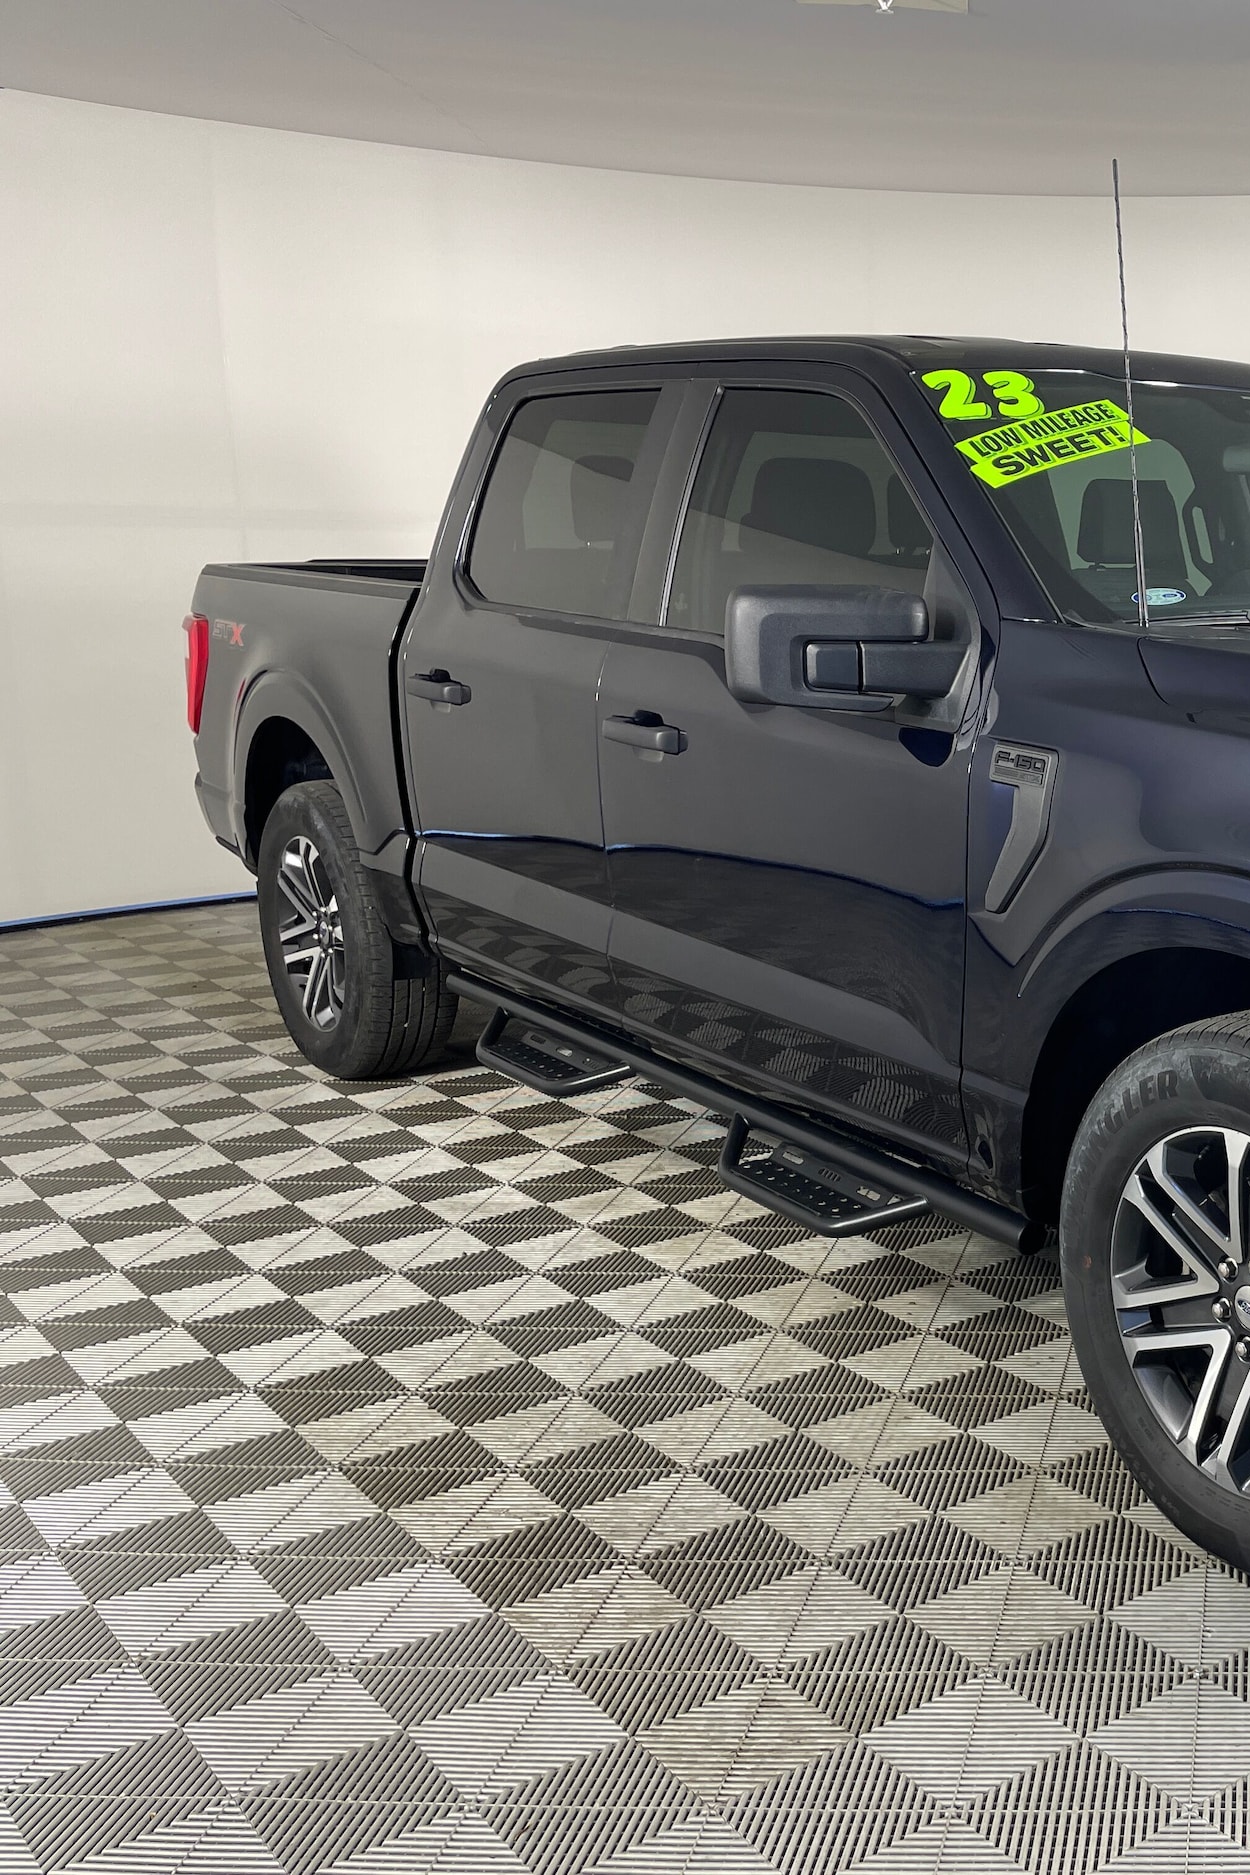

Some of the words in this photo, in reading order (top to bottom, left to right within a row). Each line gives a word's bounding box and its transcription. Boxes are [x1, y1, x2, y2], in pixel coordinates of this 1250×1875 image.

[921, 369, 1045, 420] 23
[968, 427, 1027, 458] LOW
[1025, 402, 1117, 441] MILEAGE
[991, 424, 1128, 477] SWEET!
[212, 619, 247, 647] STX
[995, 750, 1046, 773] F-150
